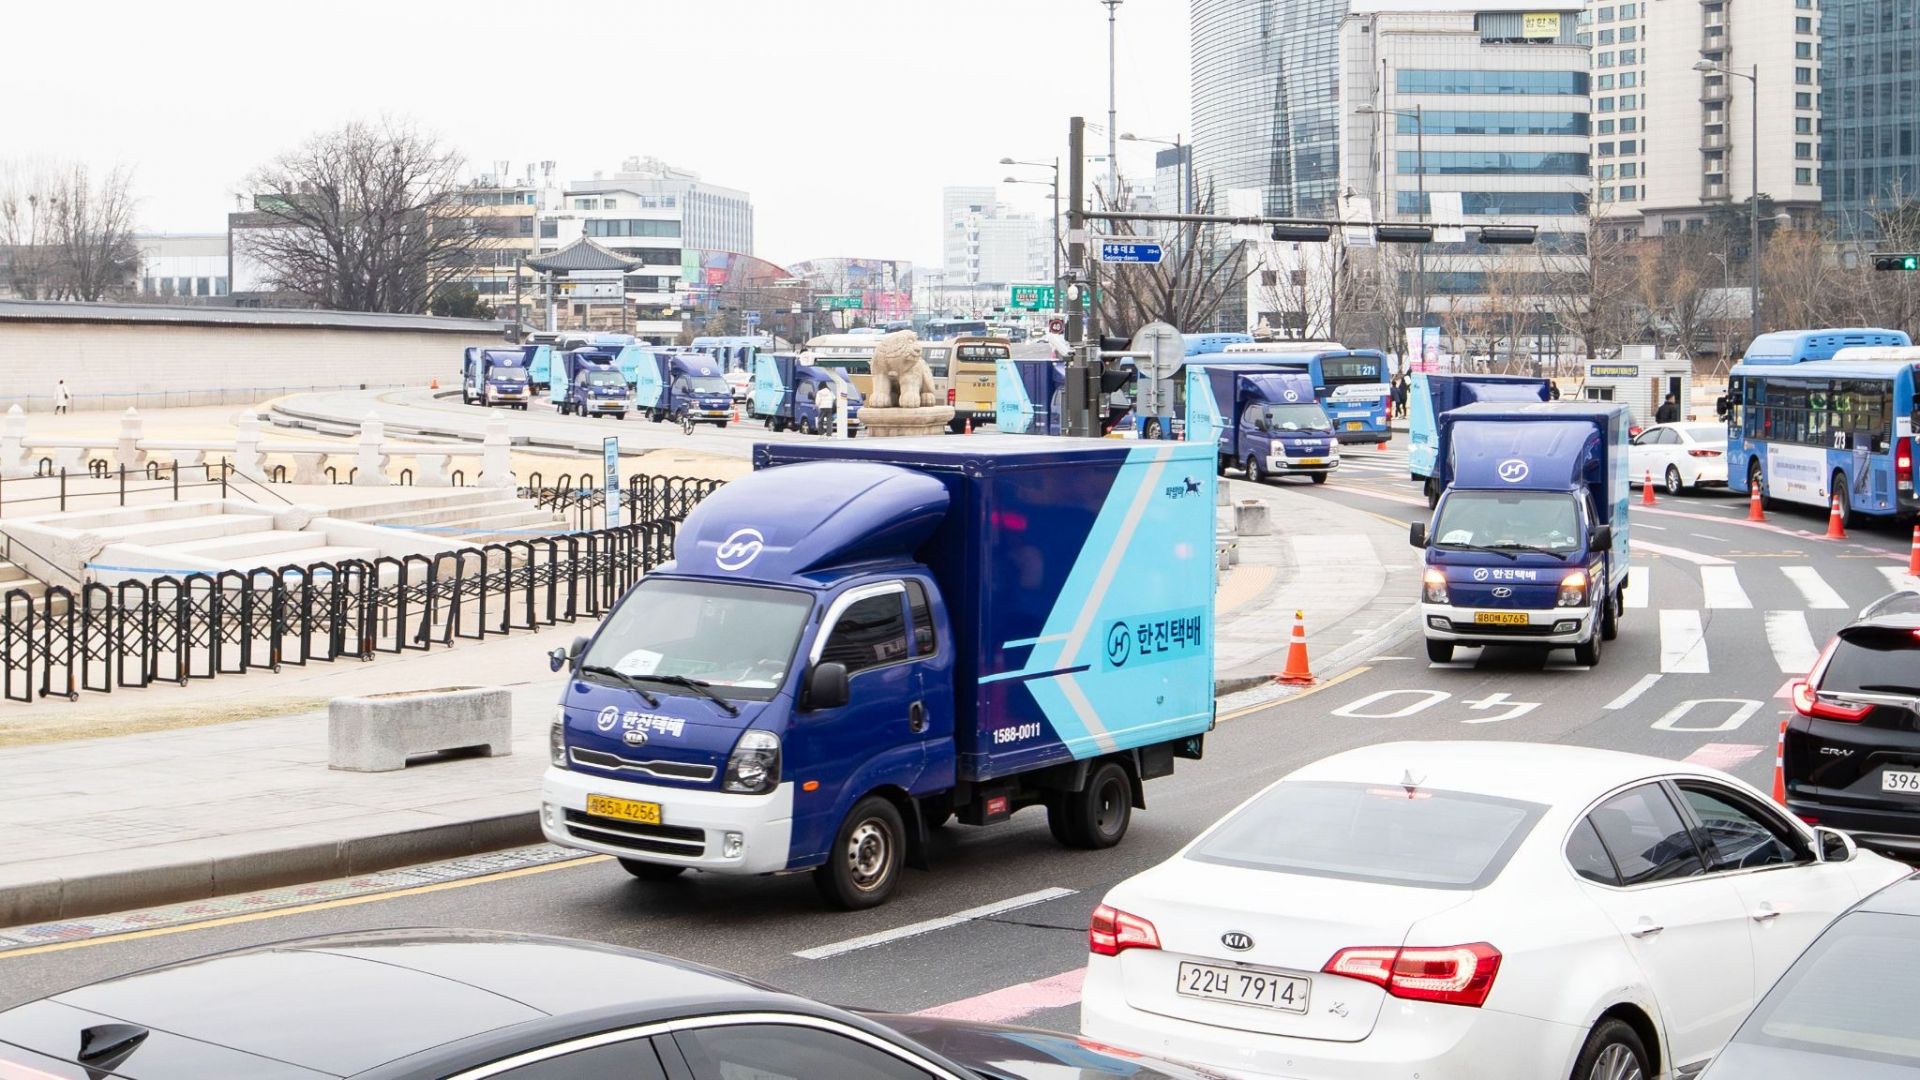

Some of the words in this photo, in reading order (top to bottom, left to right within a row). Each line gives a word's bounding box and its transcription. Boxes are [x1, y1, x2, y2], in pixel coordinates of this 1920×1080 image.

[1104, 245, 1136, 255] 세종대로
[1362, 366, 1376, 376] 271
[1834, 431, 1846, 450] 273
[1493, 569, 1537, 581] 한진택배
[1502, 614, 1526, 624] 6765
[1136, 615, 1201, 656] 한진택배
[623, 711, 685, 737] 한진택배
[625, 732, 644, 744] KIA
[993, 722, 1041, 745] 1588-0011
[1819, 747, 1855, 757] CR-V
[624, 803, 657, 821] 4256
[1224, 933, 1249, 948] KIA
[1190, 968, 1228, 994] 22너
[1241, 975, 1294, 1004] 7914
